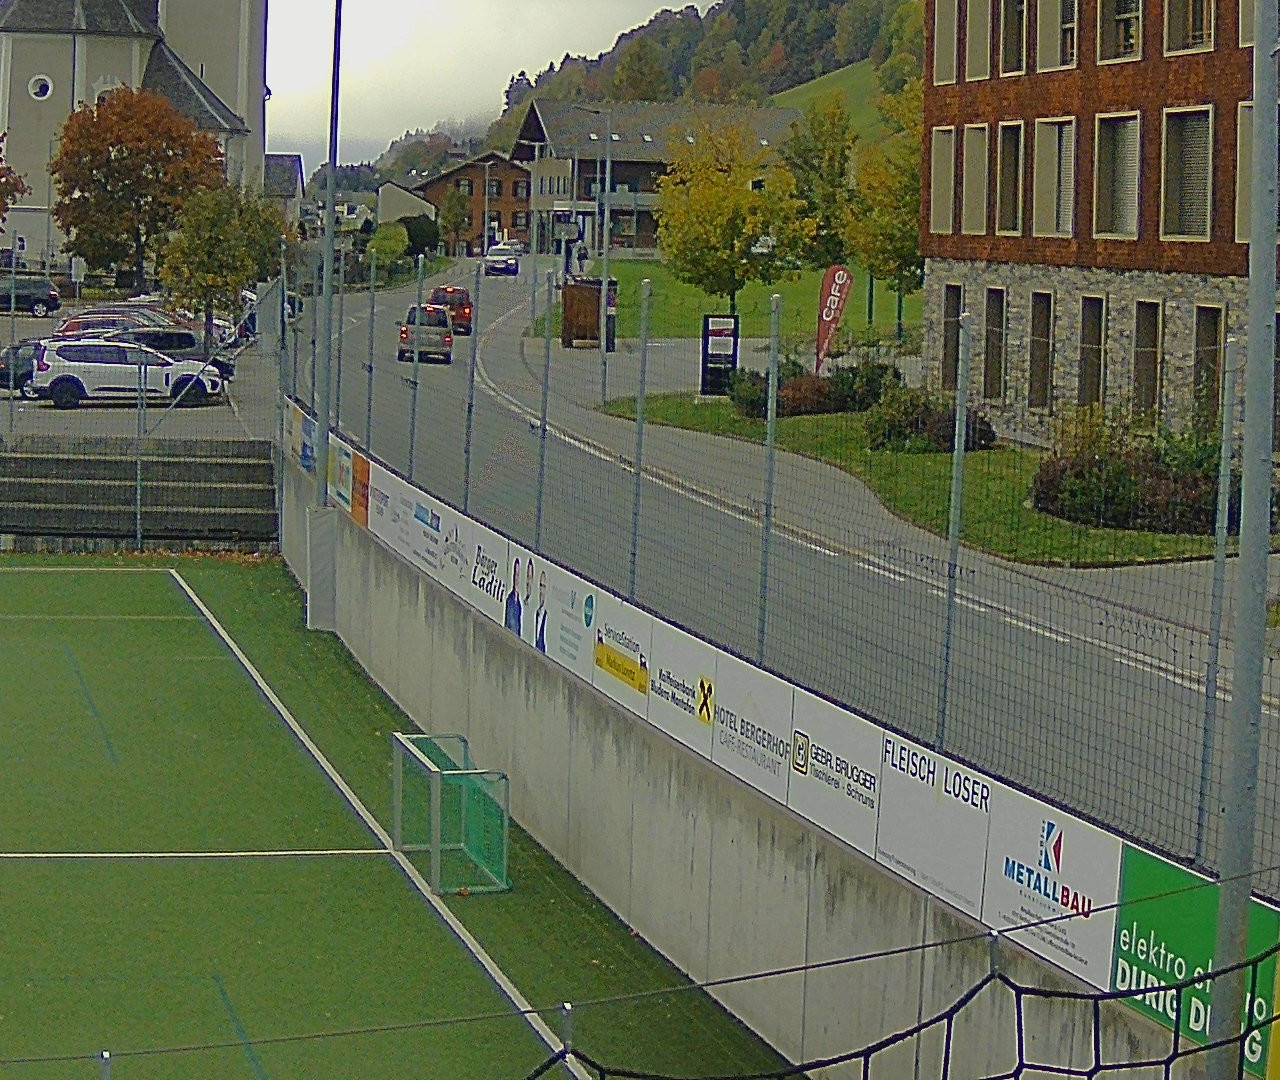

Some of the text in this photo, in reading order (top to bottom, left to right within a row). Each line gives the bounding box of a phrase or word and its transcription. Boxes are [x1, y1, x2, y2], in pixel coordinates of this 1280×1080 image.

[714, 703, 738, 733] HOTEL
[740, 717, 791, 760] BERGERHOF
[810, 743, 834, 770] GEBR.
[846, 783, 875, 809] Schruns
[884, 738, 990, 813] FLEISCH LOSER
[1004, 856, 1092, 919] METALLBAU
[1120, 921, 1186, 980] elektro
